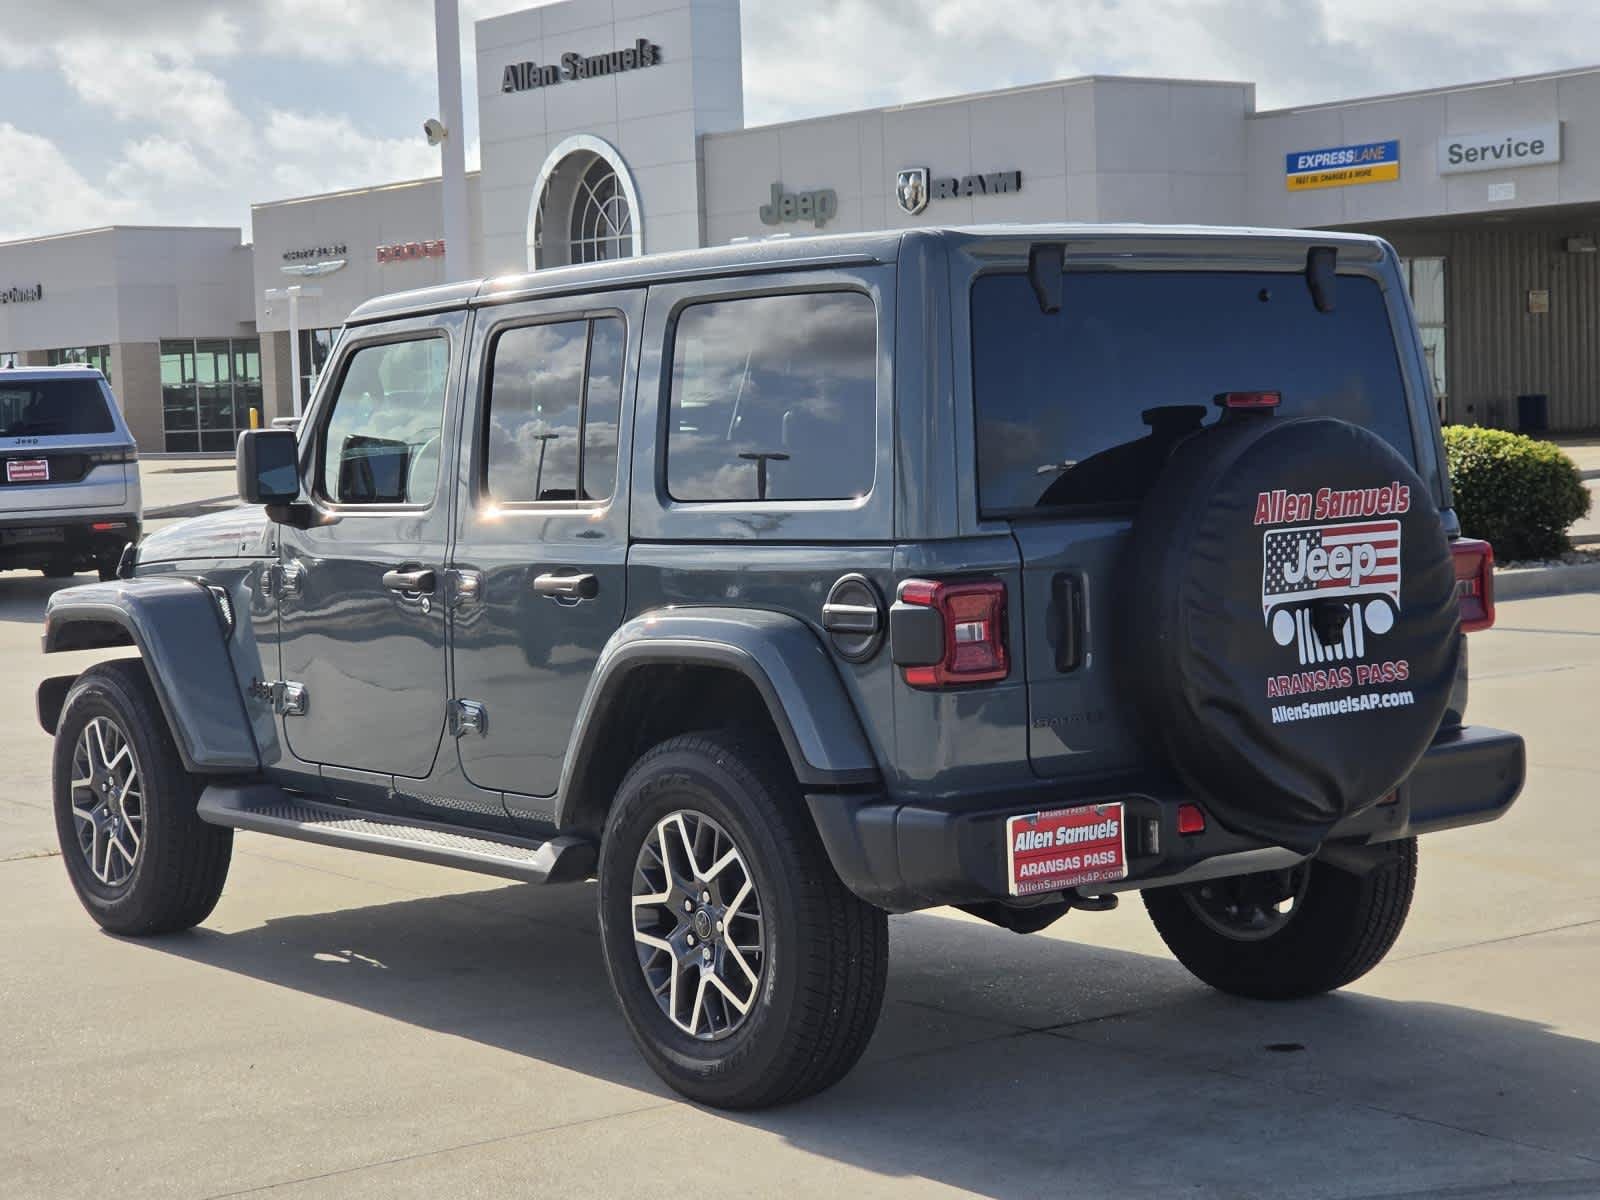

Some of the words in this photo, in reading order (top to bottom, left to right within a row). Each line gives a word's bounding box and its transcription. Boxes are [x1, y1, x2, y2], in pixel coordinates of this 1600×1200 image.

[502, 61, 561, 93] Allen
[561, 38, 663, 80] Samuels
[1448, 137, 1545, 164] Service
[932, 170, 1022, 200] RAM
[759, 180, 838, 228] Jeep
[1254, 489, 1312, 525] Allen
[1315, 481, 1410, 520] Samuels
[1283, 539, 1377, 587] Jeep
[1267, 667, 1353, 698] ARANSAS
[1356, 660, 1409, 685] PASS
[1271, 690, 1415, 724] AllenSamuelsAP.com
[1014, 830, 1053, 852] Allen
[1055, 818, 1119, 848] Samuels
[1019, 855, 1081, 877] ARANSAS
[1083, 850, 1116, 867] PASS
[1018, 868, 1124, 894] AllenSamuelsAP.com
